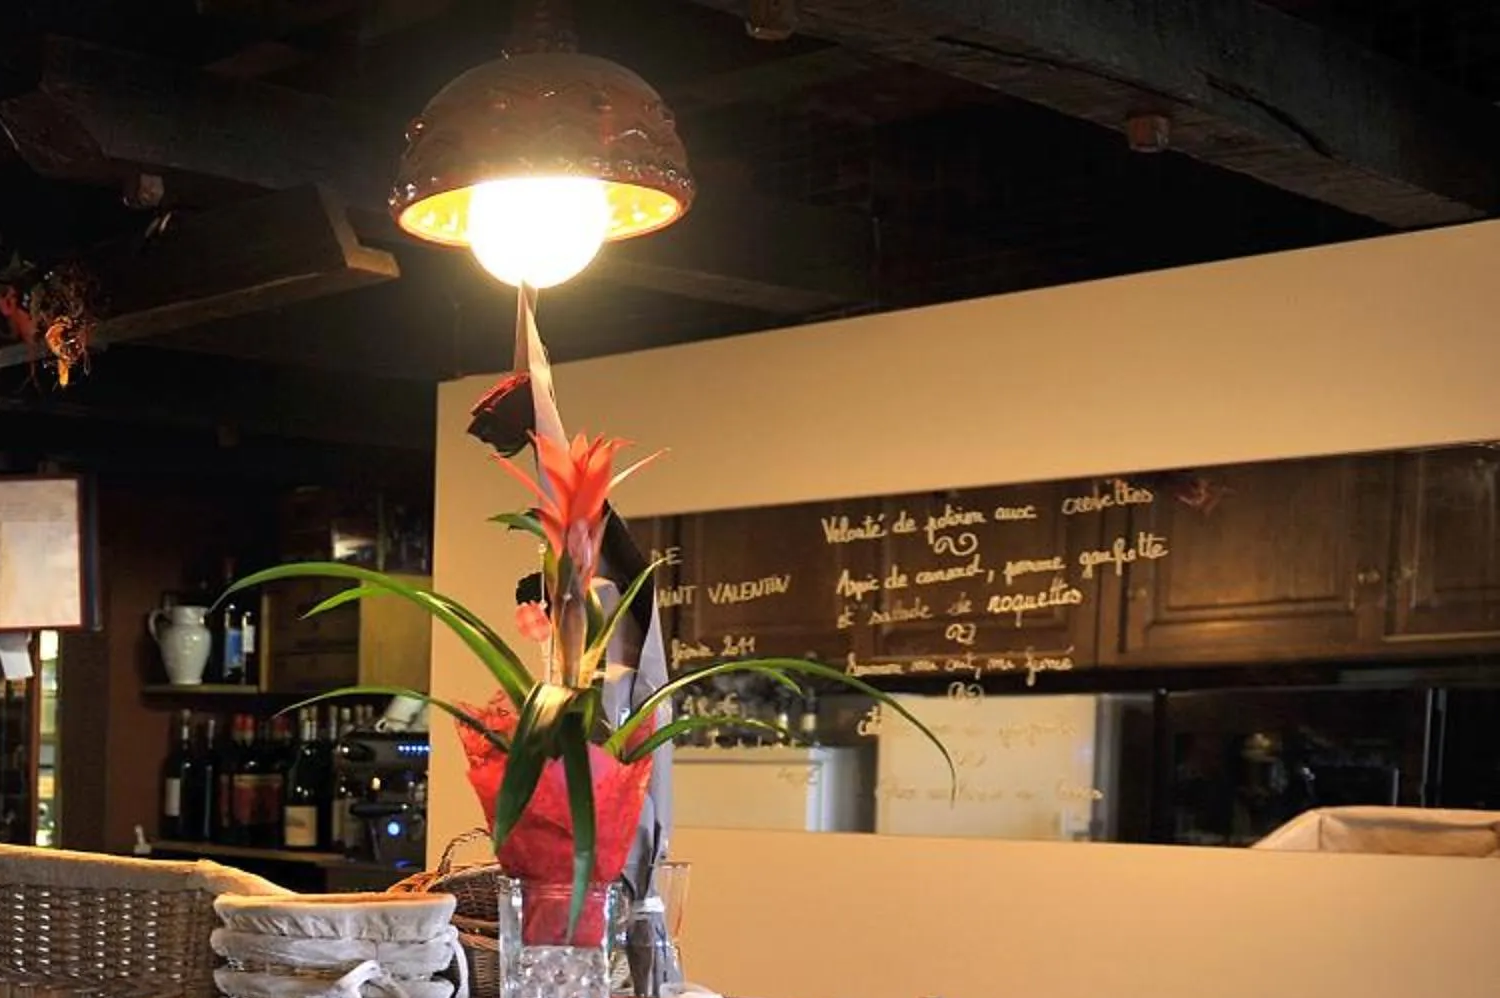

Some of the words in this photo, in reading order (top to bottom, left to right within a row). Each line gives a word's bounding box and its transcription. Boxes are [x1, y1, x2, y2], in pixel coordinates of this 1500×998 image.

[892, 510, 917, 534] de
[995, 504, 1037, 520] aux
[708, 573, 792, 605] VALENTIN
[884, 564, 909, 589] de
